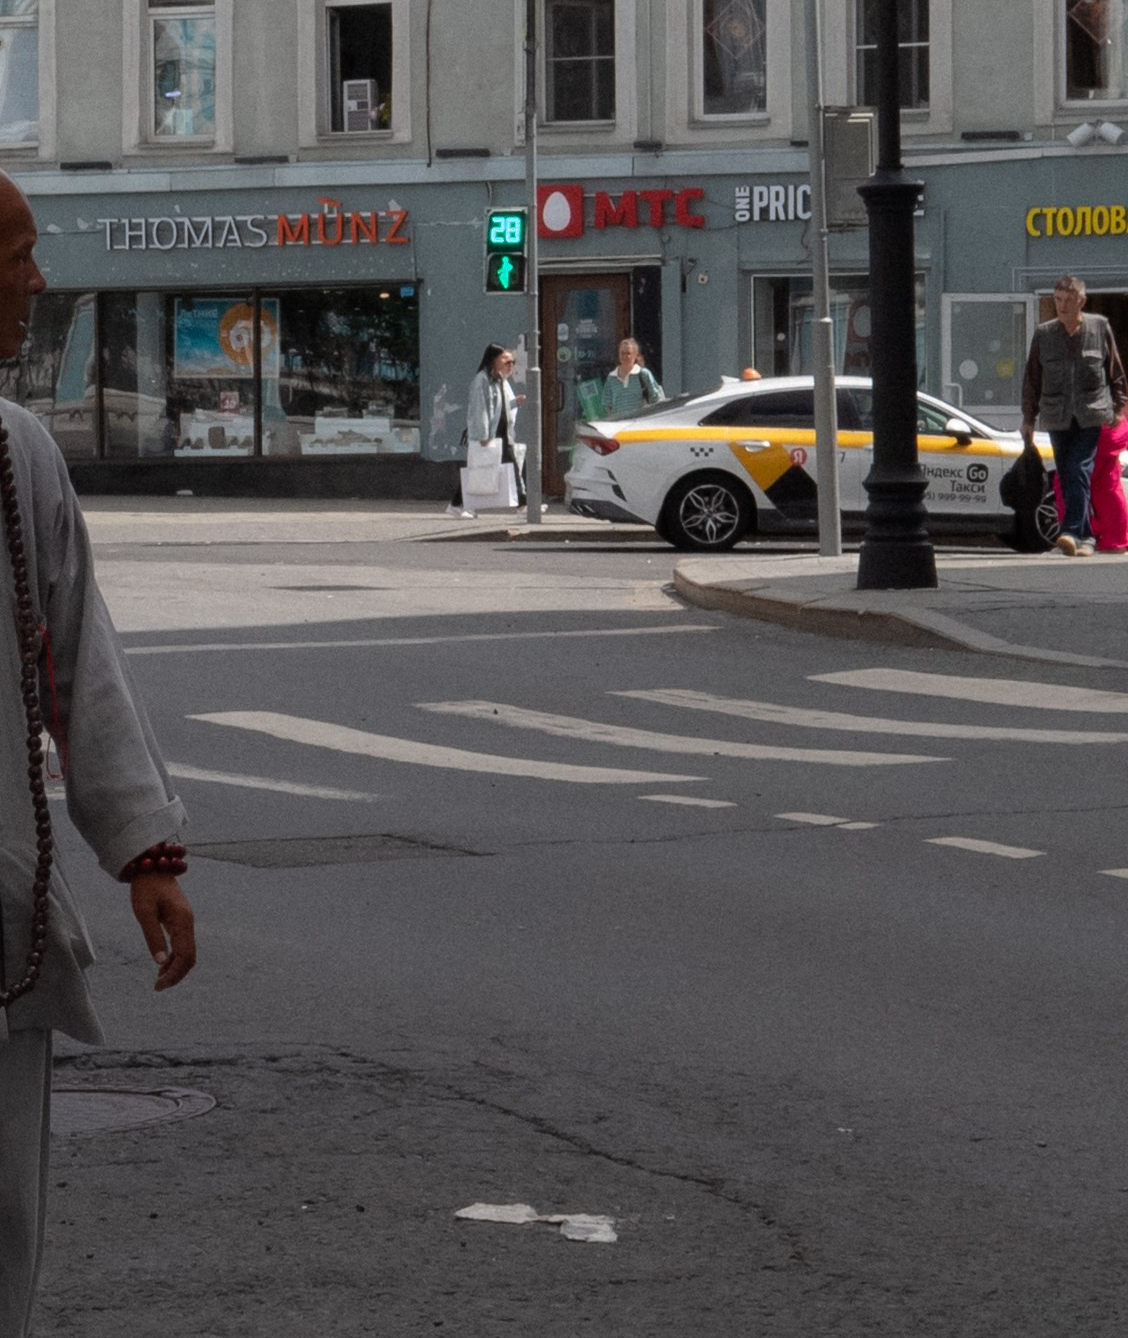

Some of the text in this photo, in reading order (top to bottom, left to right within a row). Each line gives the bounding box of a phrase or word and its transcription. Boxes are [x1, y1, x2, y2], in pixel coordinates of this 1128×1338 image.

[595, 188, 705, 230] МТС
[735, 186, 750, 222] ONE
[98, 214, 268, 250] THOMAS
[490, 216, 522, 243] 28
[1026, 205, 1128, 237] СТОЛОВ
[950, 480, 985, 493] Такси
[968, 465, 987, 480] Go
